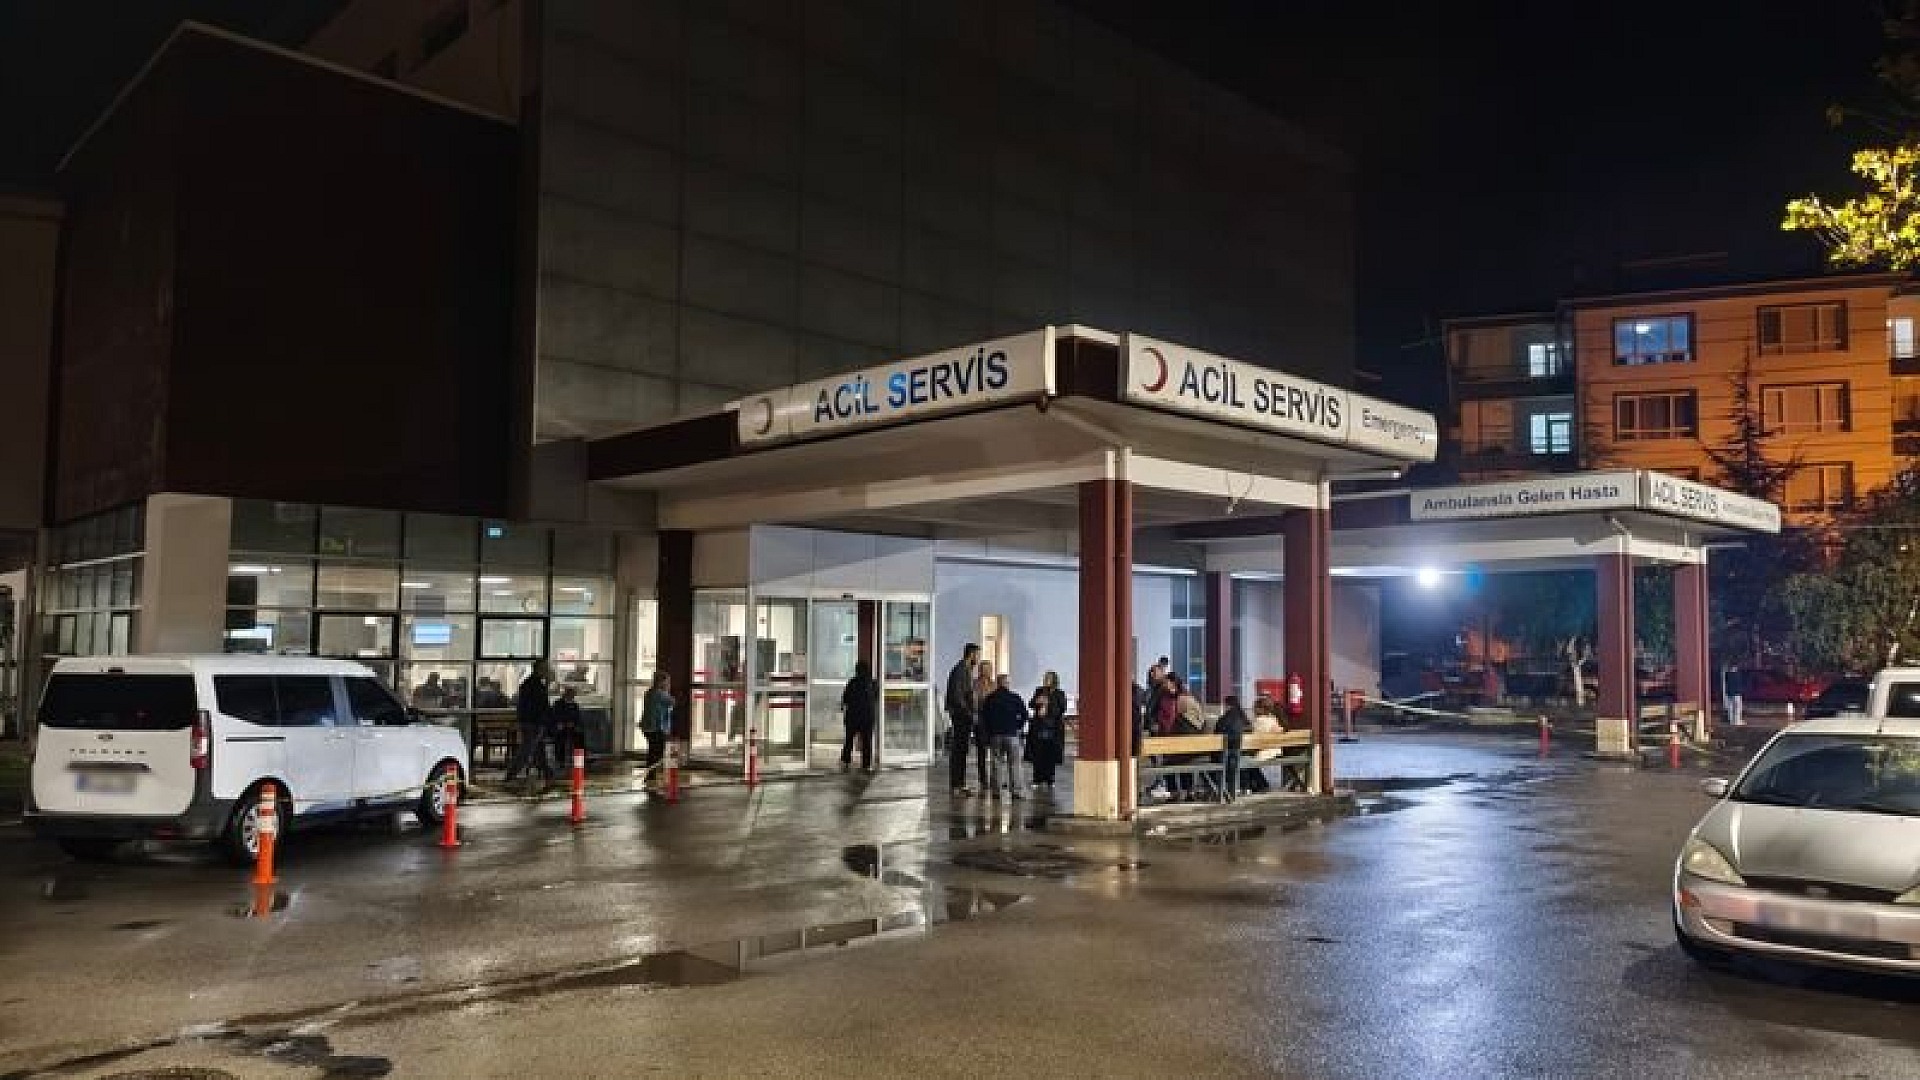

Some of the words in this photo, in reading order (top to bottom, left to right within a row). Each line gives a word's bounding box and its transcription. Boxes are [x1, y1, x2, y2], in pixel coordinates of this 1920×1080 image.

[814, 374, 880, 422] ACİL
[888, 347, 1008, 408] SERVİS
[1178, 361, 1245, 409] ACİL
[1254, 379, 1342, 430] SERVİS
[1571, 486, 1618, 500] Hasta
